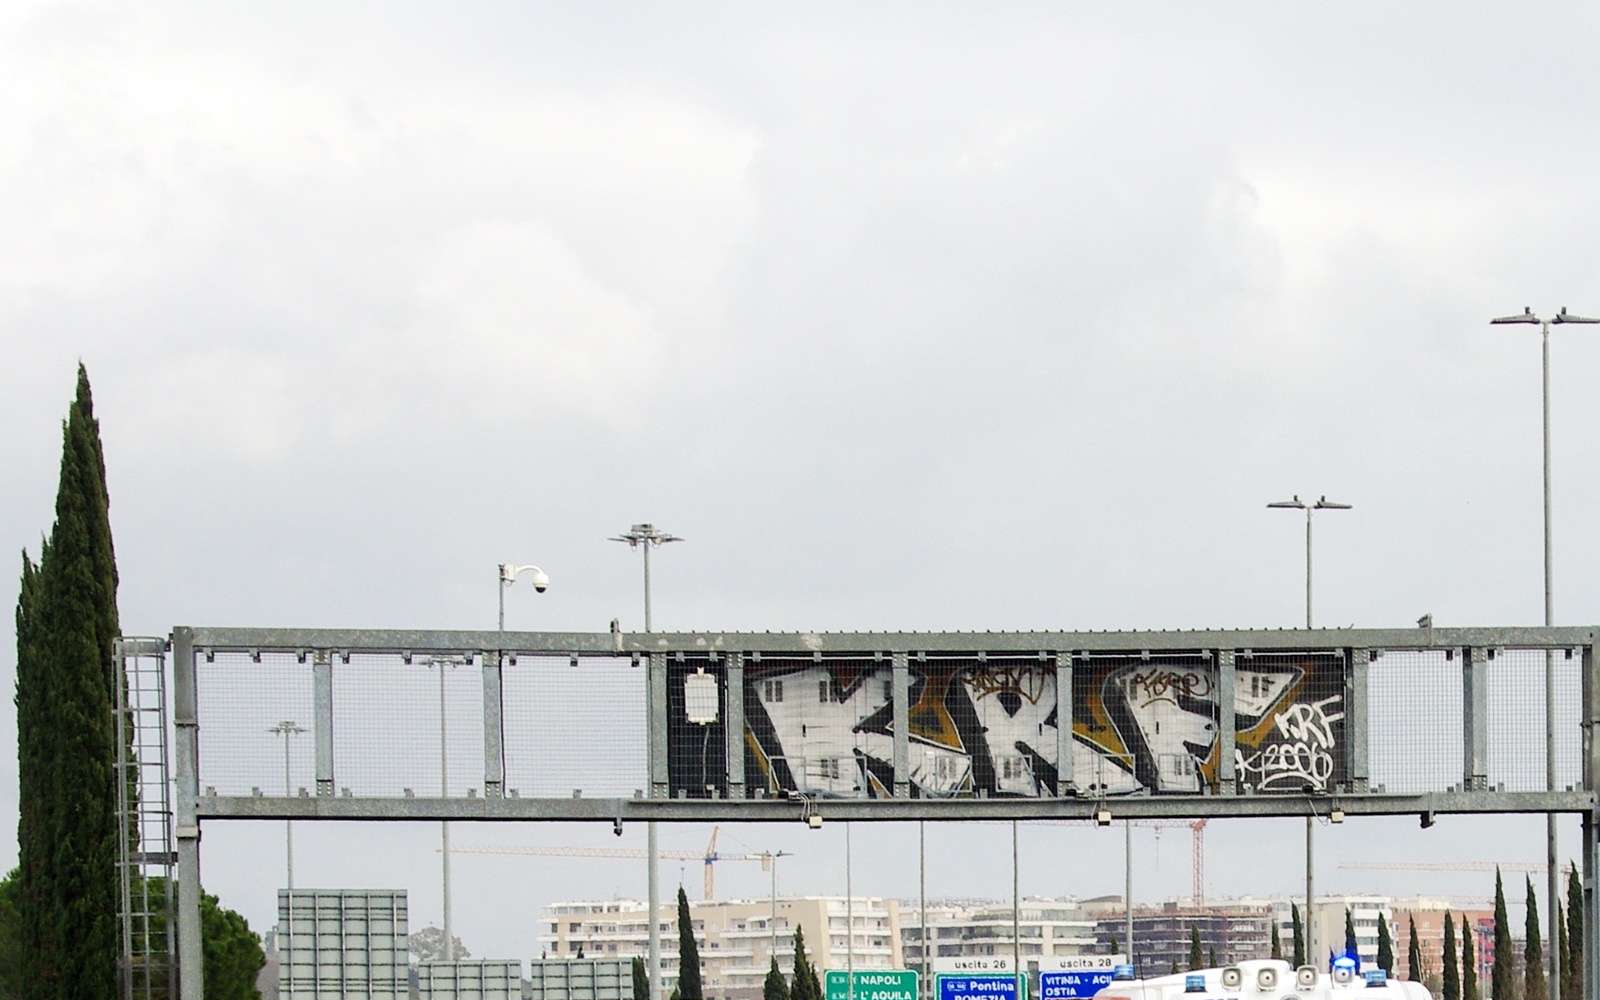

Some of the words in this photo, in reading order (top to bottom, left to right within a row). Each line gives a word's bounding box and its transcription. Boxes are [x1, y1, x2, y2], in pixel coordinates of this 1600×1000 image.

[955, 960, 988, 969] uscita
[993, 960, 1007, 969] 26
[1060, 959, 1093, 968] uscita
[1098, 958, 1112, 967] 28
[860, 975, 902, 985] NAPOLI
[1045, 975, 1081, 986] VITINIA
[970, 980, 1015, 992] Pontina
[871, 991, 912, 1000] AQUILA
[1045, 987, 1077, 997] OSTIA
